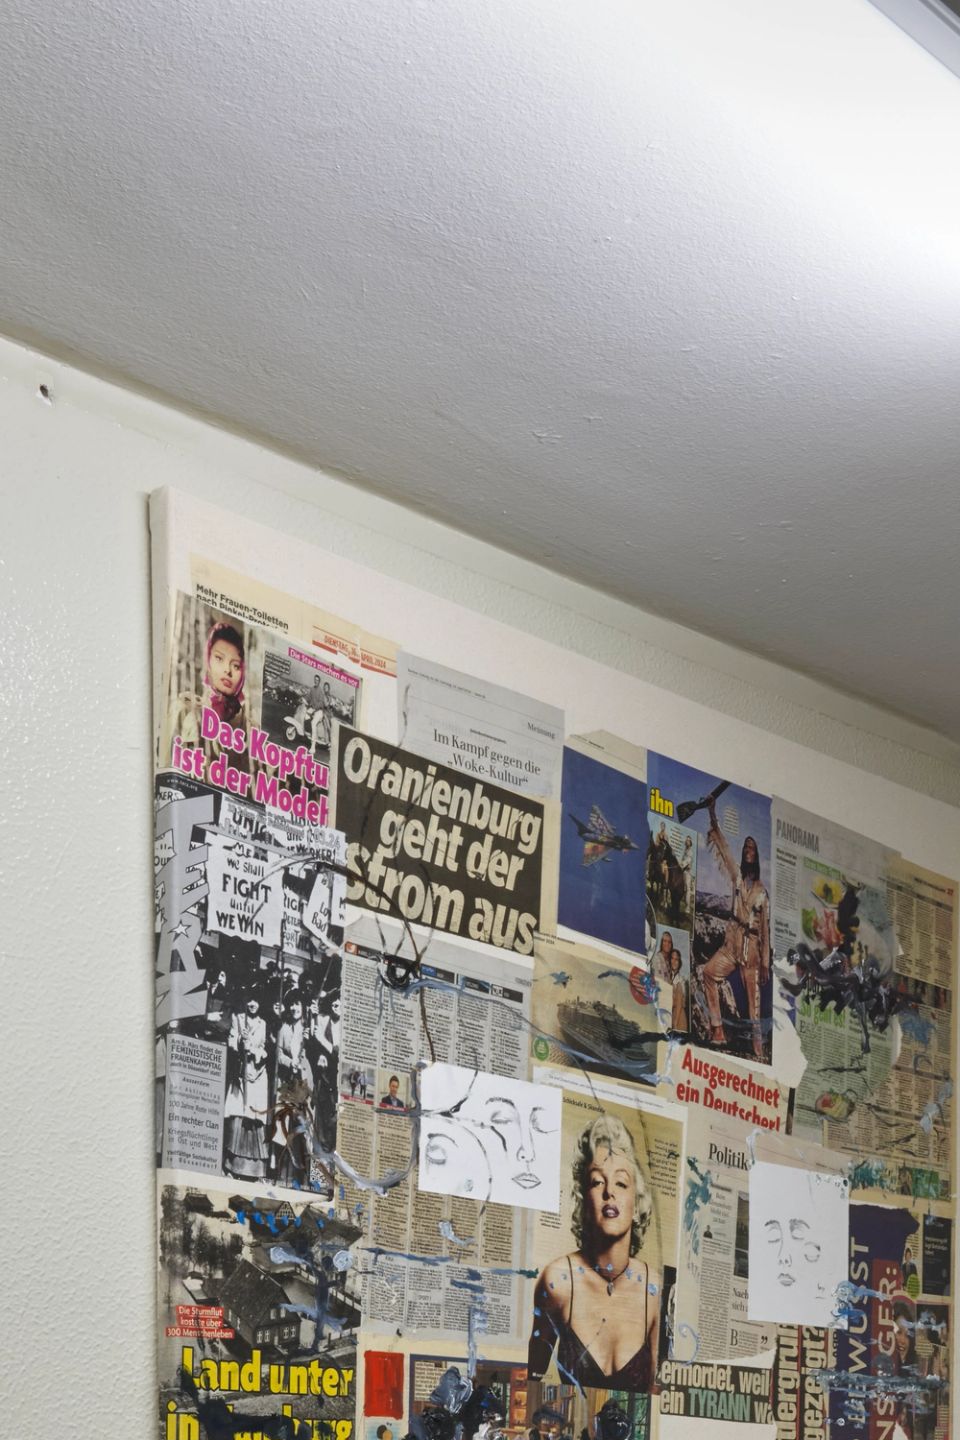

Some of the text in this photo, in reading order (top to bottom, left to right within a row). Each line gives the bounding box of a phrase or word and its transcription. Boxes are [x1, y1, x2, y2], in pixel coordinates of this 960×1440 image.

[196, 583, 289, 630] Mehr Frauen-Toiletten
[301, 653, 318, 668] Stars
[317, 661, 340, 679] machen
[201, 706, 245, 753] Das
[172, 736, 206, 778] ist
[210, 752, 251, 797] der
[434, 729, 449, 744] Im
[452, 734, 489, 759] Kampf
[490, 750, 523, 769] gegen
[524, 759, 541, 776] die
[344, 736, 542, 855] Oranienburg
[650, 788, 674, 819] ihn
[379, 810, 525, 891] geht der
[775, 818, 820, 853] PANORAMA
[221, 873, 272, 903] FIGHT
[216, 911, 265, 938] WE WIN
[468, 897, 537, 955] aus
[676, 1080, 699, 1103] ein
[682, 1048, 780, 1109] Ausgerechnet
[205, 1119, 219, 1130] Clan
[708, 1142, 749, 1171] Politik
[178, 1306, 190, 1315] Die
[206, 1318, 222, 1328] über
[167, 1328, 181, 1337] 300
[181, 1346, 354, 1398] Land unter
[661, 1360, 770, 1396] ermordet, weil
[660, 1386, 685, 1415] ein
[688, 1388, 751, 1421] TYRANN
